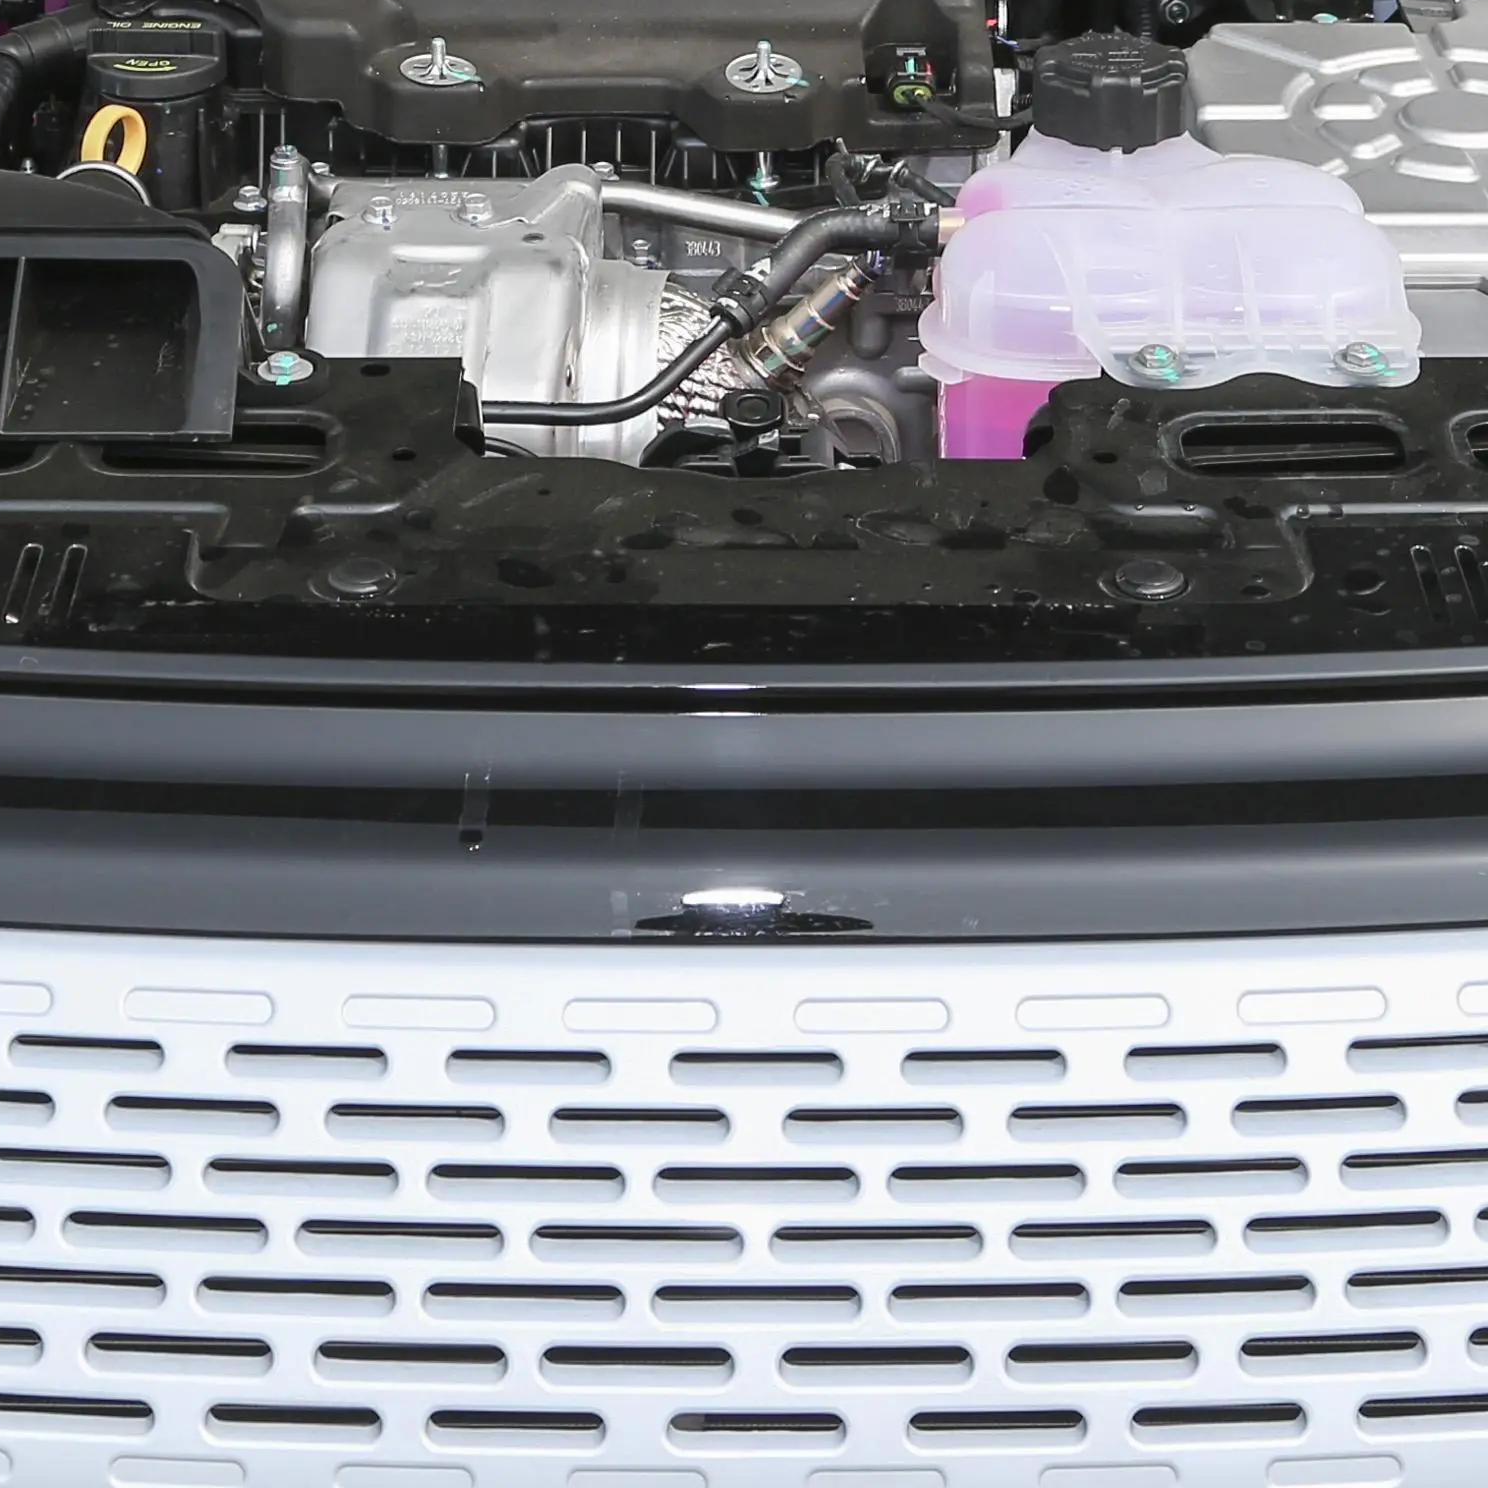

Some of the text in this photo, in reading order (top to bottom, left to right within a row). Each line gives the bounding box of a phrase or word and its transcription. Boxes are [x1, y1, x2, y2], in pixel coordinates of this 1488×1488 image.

[106, 21, 202, 30] ENGINE OIL
[125, 57, 171, 67] OPEN
